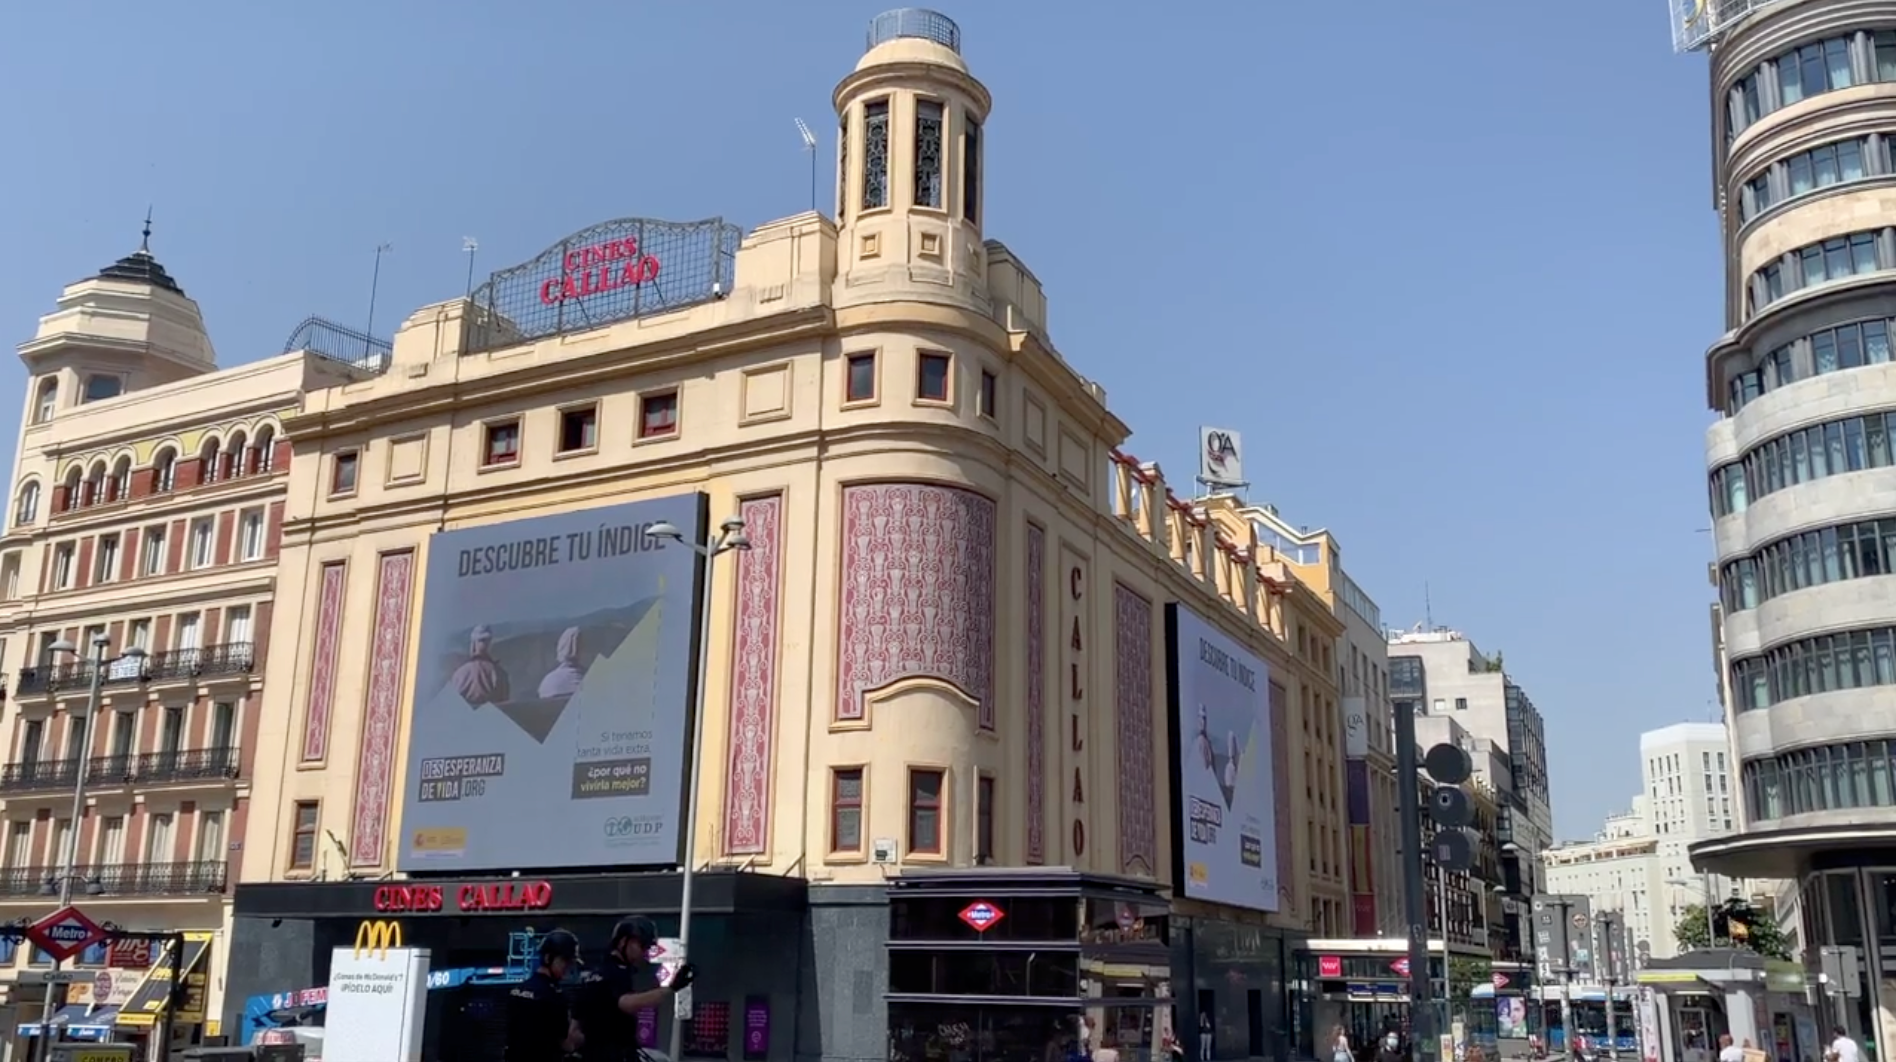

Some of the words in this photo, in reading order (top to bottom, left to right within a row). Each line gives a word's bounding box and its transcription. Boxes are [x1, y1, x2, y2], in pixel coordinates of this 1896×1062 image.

[563, 235, 638, 270] CINES
[540, 254, 660, 305] CALLAO
[458, 535, 560, 578] DESCUBRE
[566, 531, 592, 562] TU
[1070, 566, 1085, 857] CALLAO
[588, 766, 611, 779] ¿por
[613, 764, 631, 777] qué
[633, 764, 647, 775] no
[422, 782, 435, 799] DE
[612, 777, 646, 791] mejor?
[634, 822, 664, 835] UDP
[374, 884, 443, 911] CINES
[458, 880, 552, 911] CALLAO
[970, 909, 991, 919] Metro
[51, 924, 86, 940] Metro
